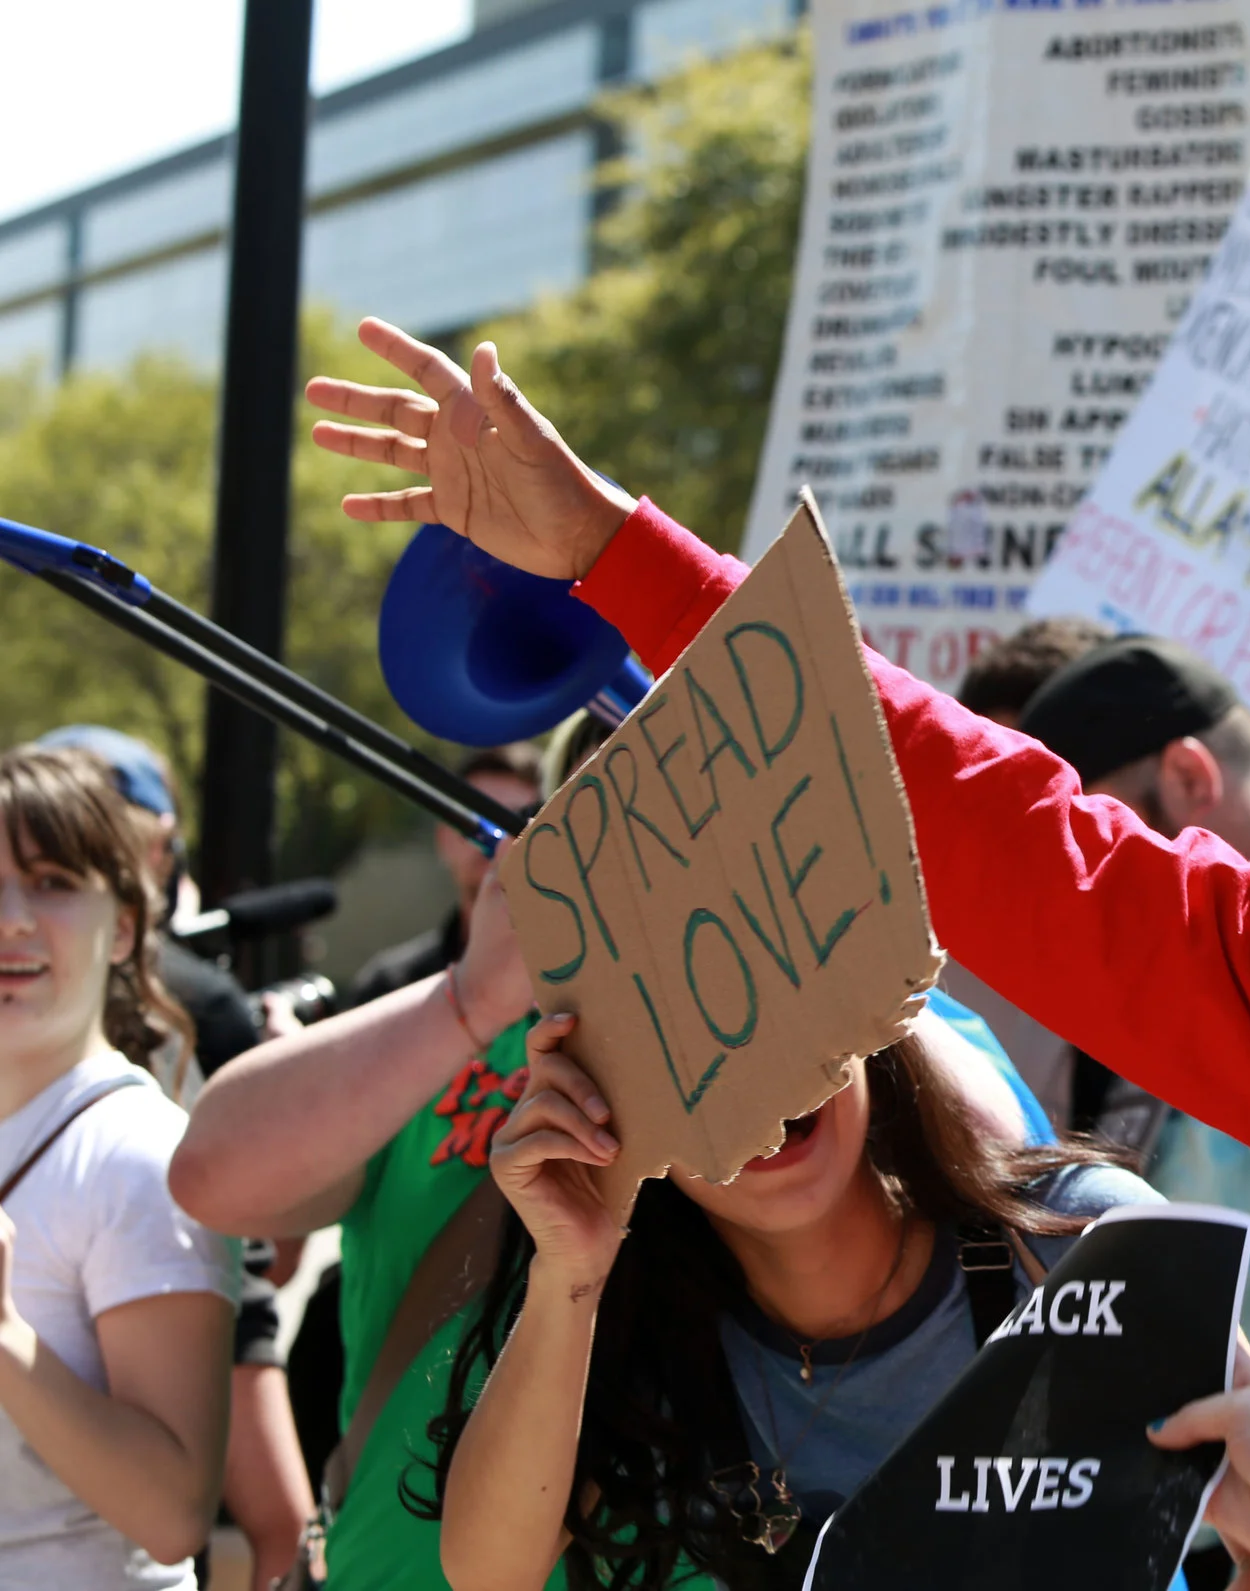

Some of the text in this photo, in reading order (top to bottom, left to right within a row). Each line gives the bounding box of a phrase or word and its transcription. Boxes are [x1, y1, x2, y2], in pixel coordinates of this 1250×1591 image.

[1131, 254, 1214, 287] MOUT
[525, 621, 805, 982] SPREAD
[633, 713, 893, 1115] LOVE!
[935, 1455, 1101, 1512] LIVES
